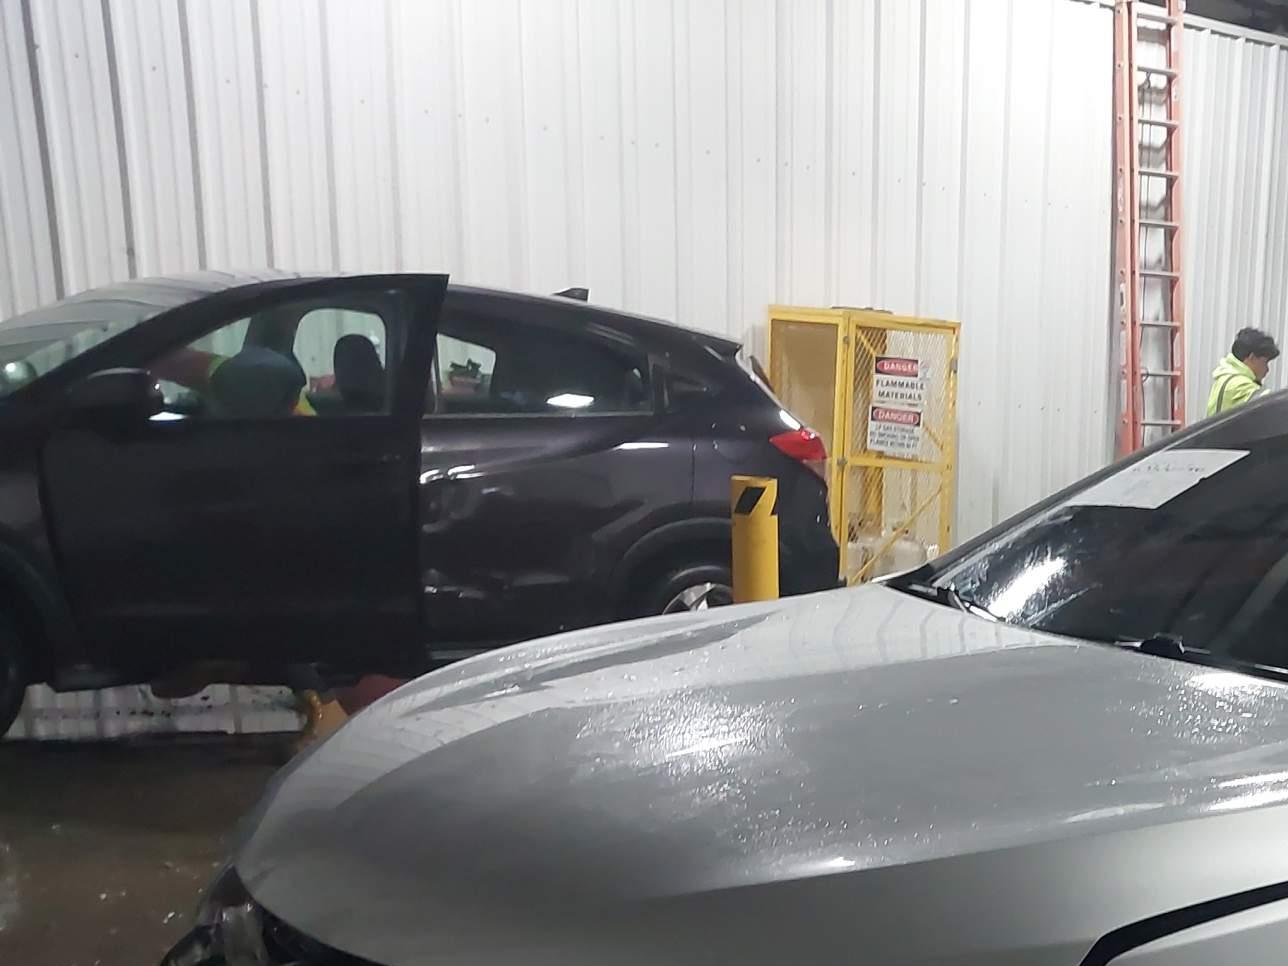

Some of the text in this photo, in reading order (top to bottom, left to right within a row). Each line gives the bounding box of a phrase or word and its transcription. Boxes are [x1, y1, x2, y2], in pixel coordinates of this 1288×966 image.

[876, 379, 924, 390] FLAMMABLE
[878, 391, 922, 401] MATERIALS
[878, 410, 914, 423] DANGER
